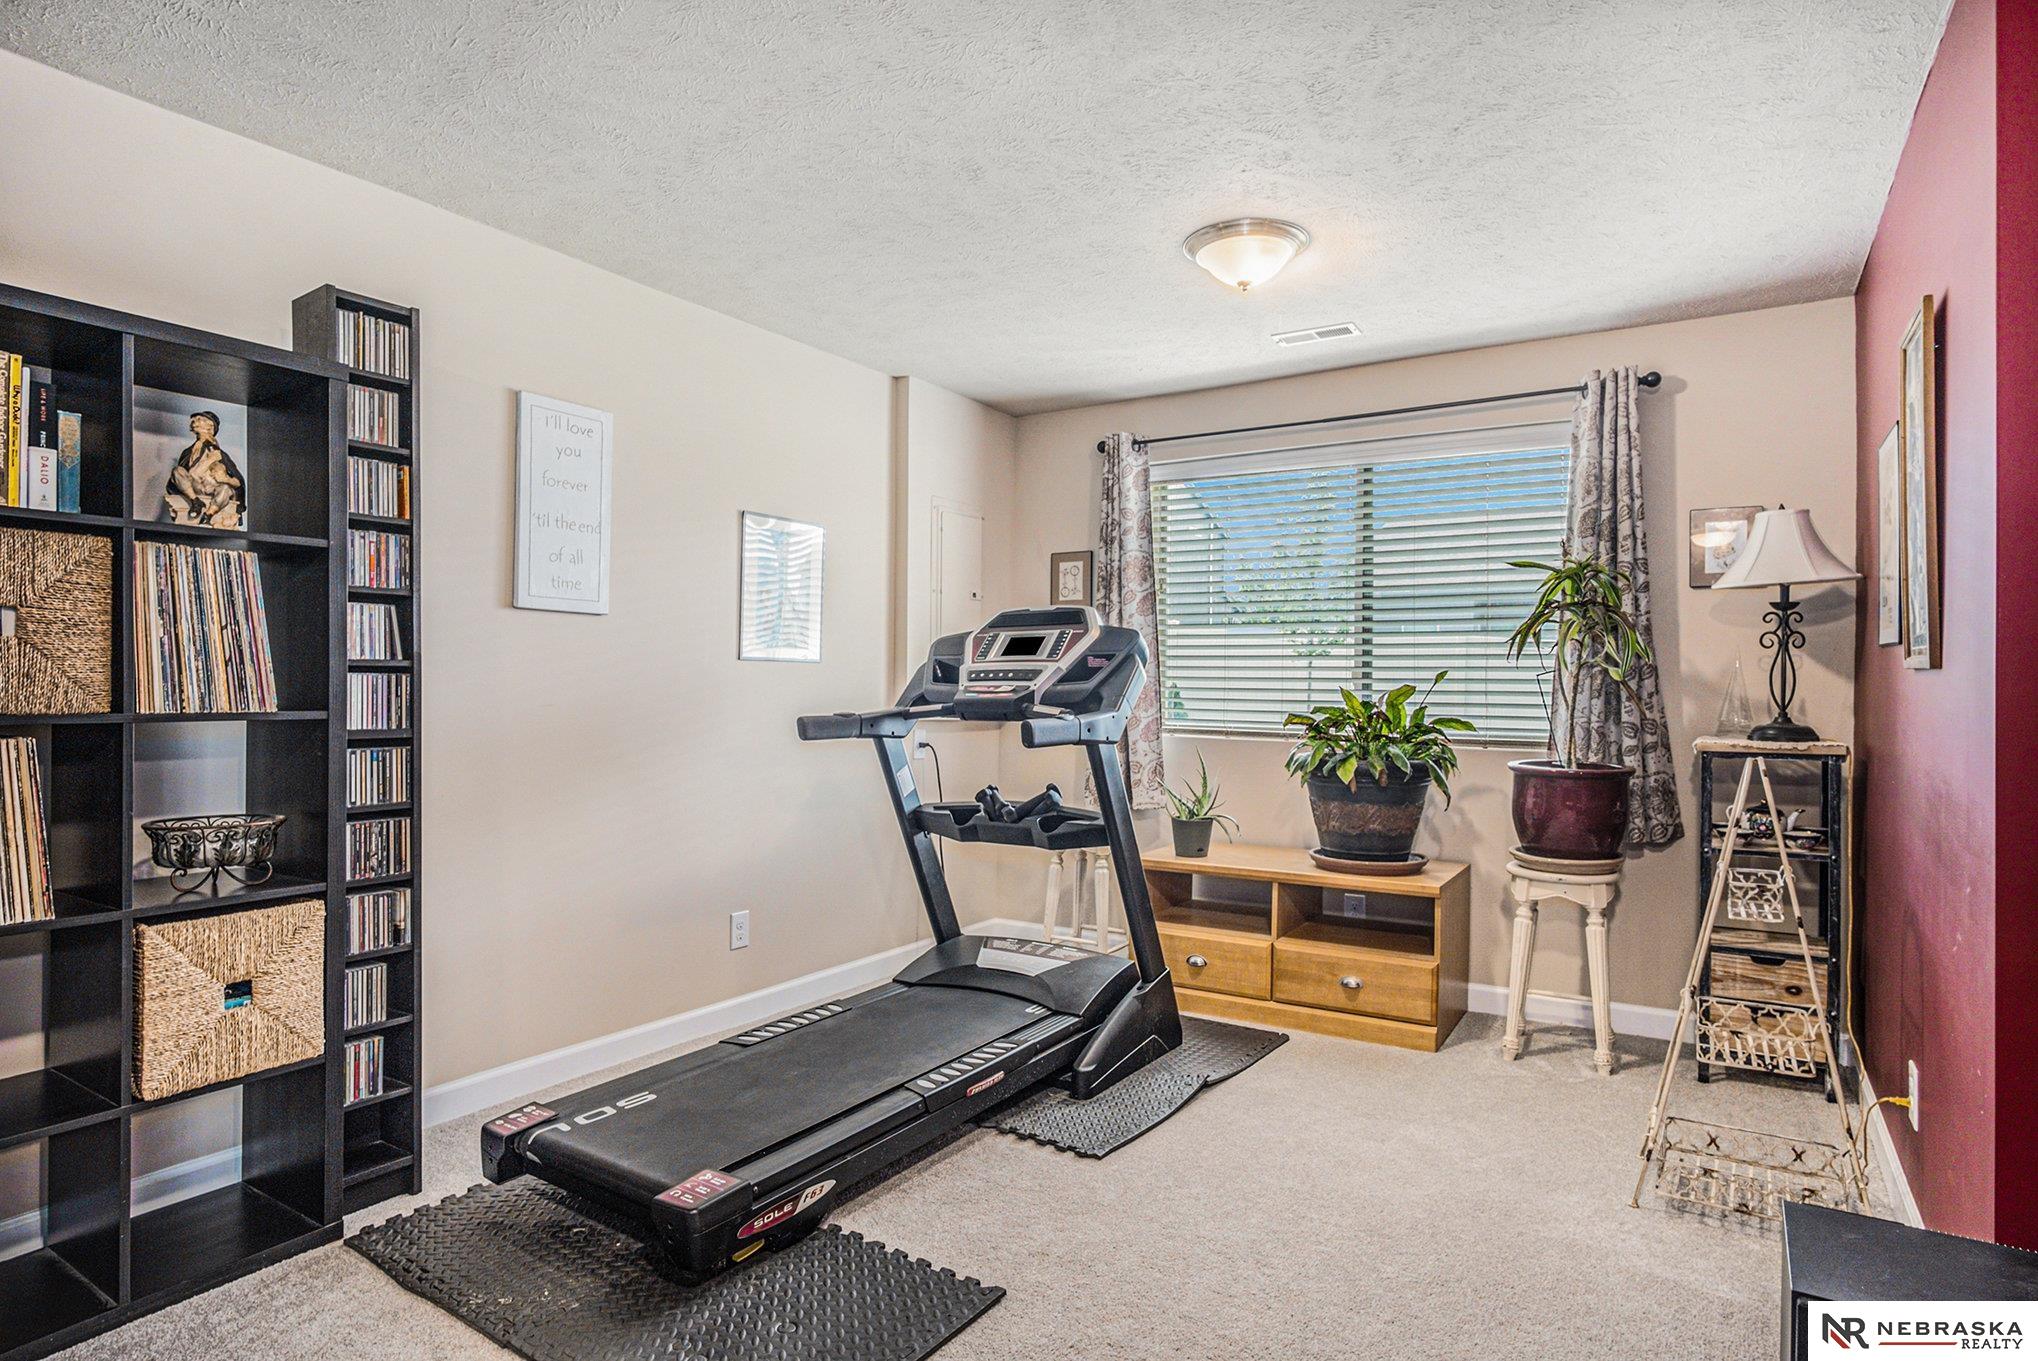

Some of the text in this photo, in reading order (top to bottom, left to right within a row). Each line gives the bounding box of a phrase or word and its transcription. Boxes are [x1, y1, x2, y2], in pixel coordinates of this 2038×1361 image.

[545, 415, 594, 438] I'll love
[556, 445, 582, 460] you
[40, 456, 49, 485] DALIO
[542, 469, 589, 492] forever
[532, 512, 602, 535] 'til the end
[549, 546, 584, 565] of all
[551, 576, 582, 590] time
[753, 1184, 825, 1228] SOLE F63
